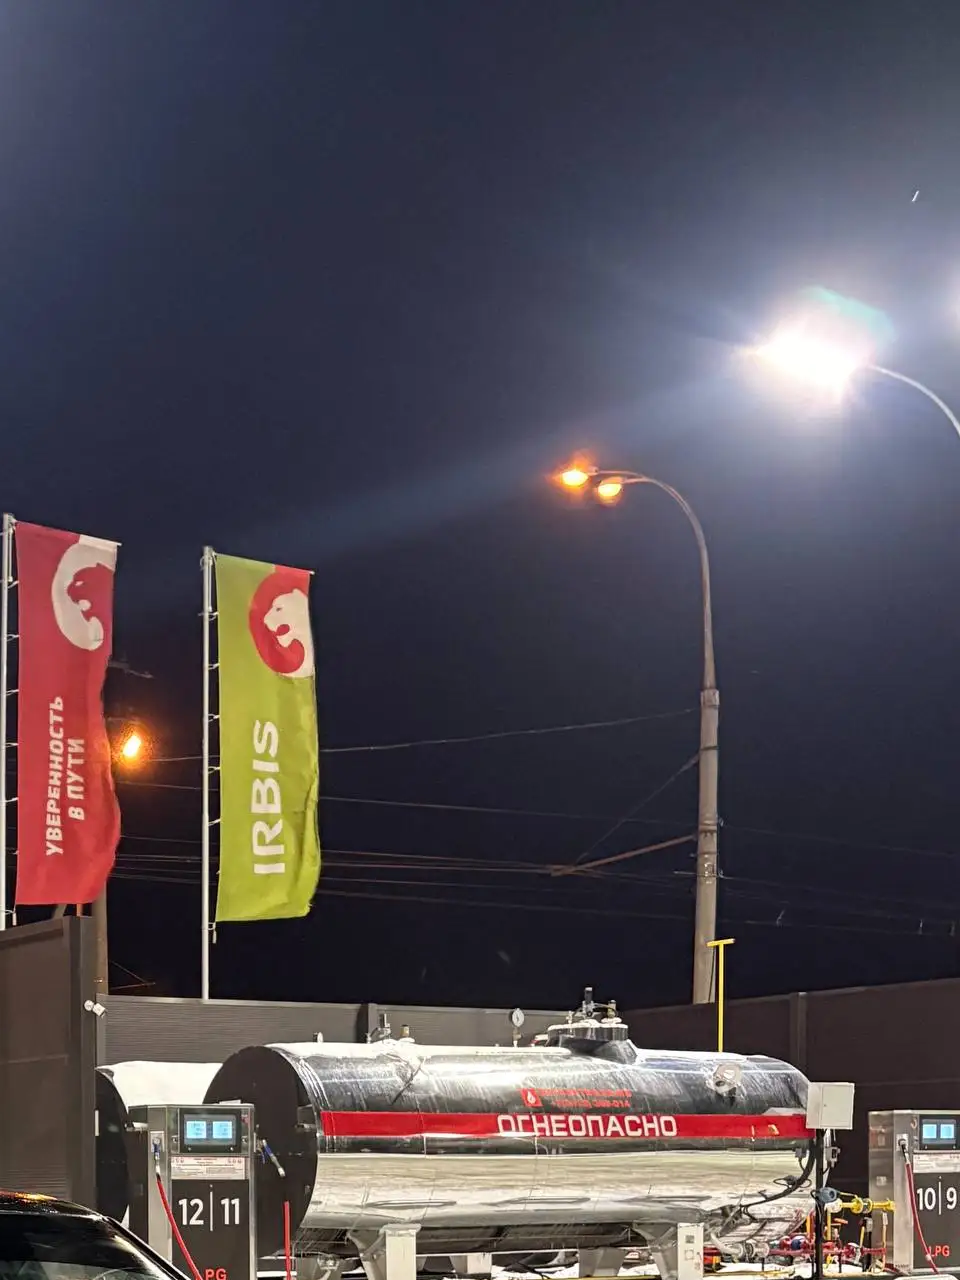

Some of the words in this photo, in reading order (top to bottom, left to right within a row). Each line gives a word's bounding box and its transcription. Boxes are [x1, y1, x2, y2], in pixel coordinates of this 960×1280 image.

[46, 696, 64, 856] УВЕРЕННОСТЬ
[67, 738, 85, 800] ПУТИ
[251, 719, 286, 874] IRBIS
[68, 806, 85, 821] В
[497, 1114, 678, 1137] ОГНЕОПАСНО
[178, 1198, 204, 1225] 12
[221, 1198, 240, 1225] 11
[916, 1187, 936, 1210] 10
[946, 1187, 957, 1210] 9
